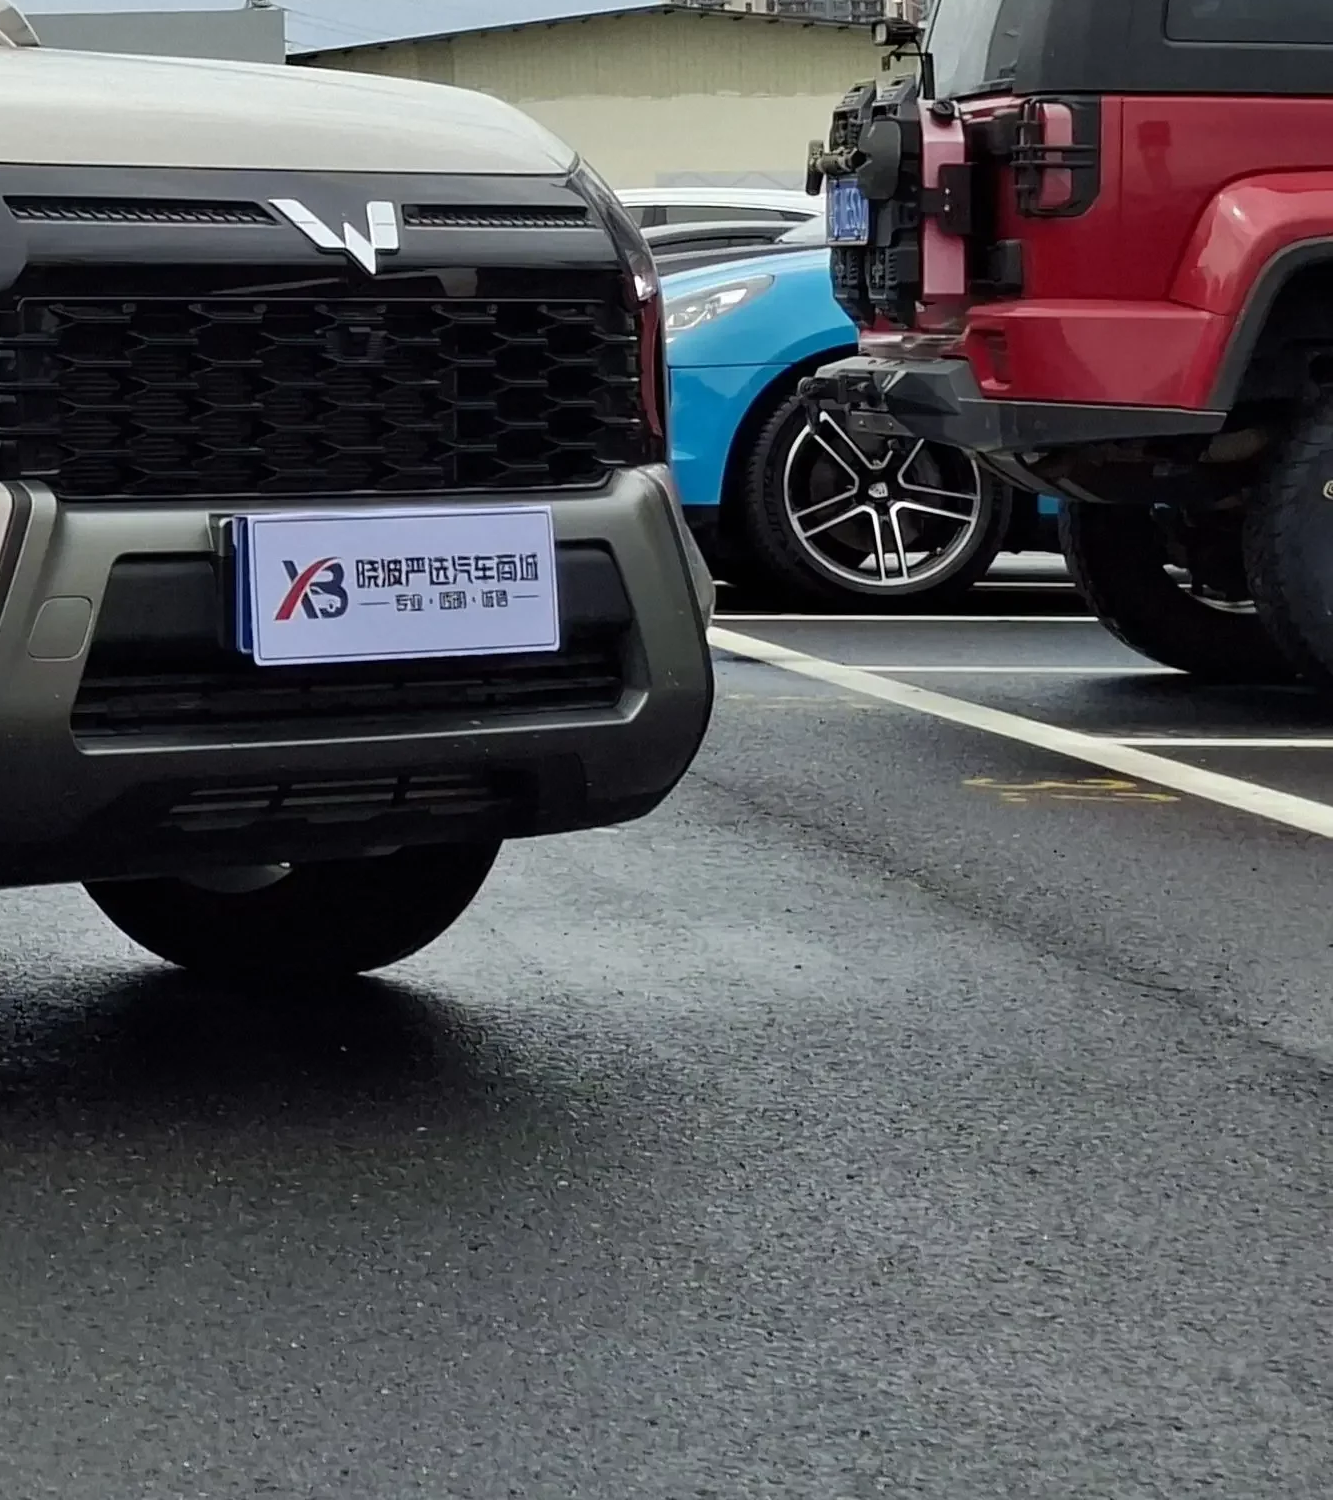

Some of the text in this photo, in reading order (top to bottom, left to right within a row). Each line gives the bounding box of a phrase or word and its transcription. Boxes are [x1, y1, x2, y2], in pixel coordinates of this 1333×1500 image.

[355, 552, 538, 588] 晓波严选汽车商城
